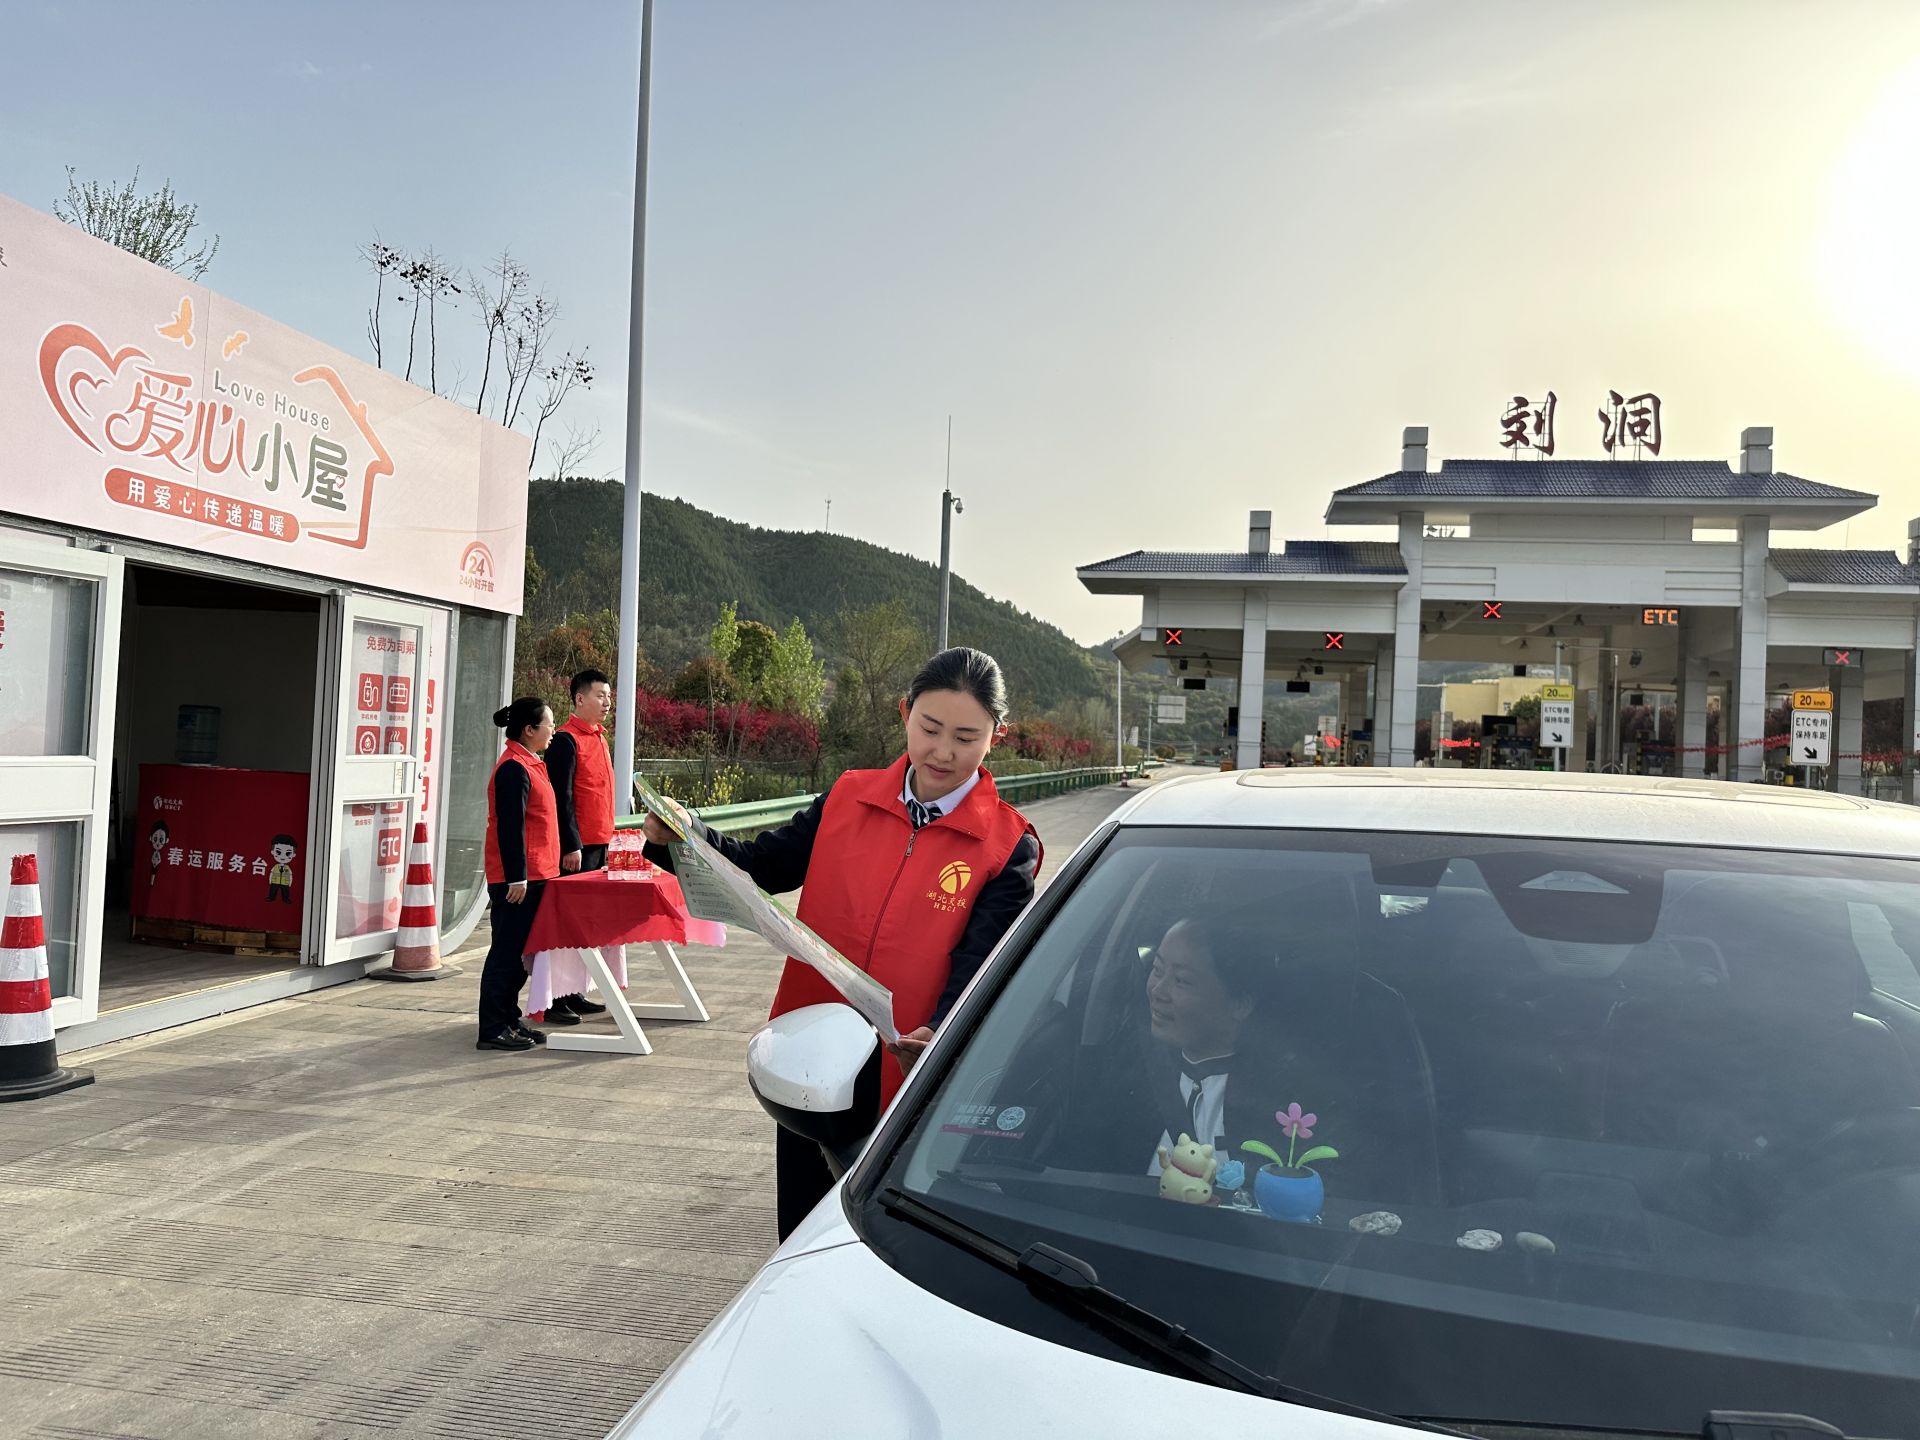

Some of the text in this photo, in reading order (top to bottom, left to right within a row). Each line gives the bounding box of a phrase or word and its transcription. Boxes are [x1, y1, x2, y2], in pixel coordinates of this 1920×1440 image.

[213, 369, 331, 431] Love House
[1499, 389, 1662, 457] 刘洞
[104, 366, 349, 513] 爱心小屋
[126, 476, 286, 538] 用爱心传递温暖
[468, 555, 485, 577] 24
[1643, 608, 1679, 625] ETC
[1546, 688, 1558, 698] 20
[1799, 694, 1812, 706] 20
[1795, 717, 1828, 728] ETC专用
[1795, 730, 1827, 740] 保持车距
[380, 836, 400, 858] ETC
[167, 848, 268, 876] 春运服务台
[927, 890, 967, 908] 湖北交投
